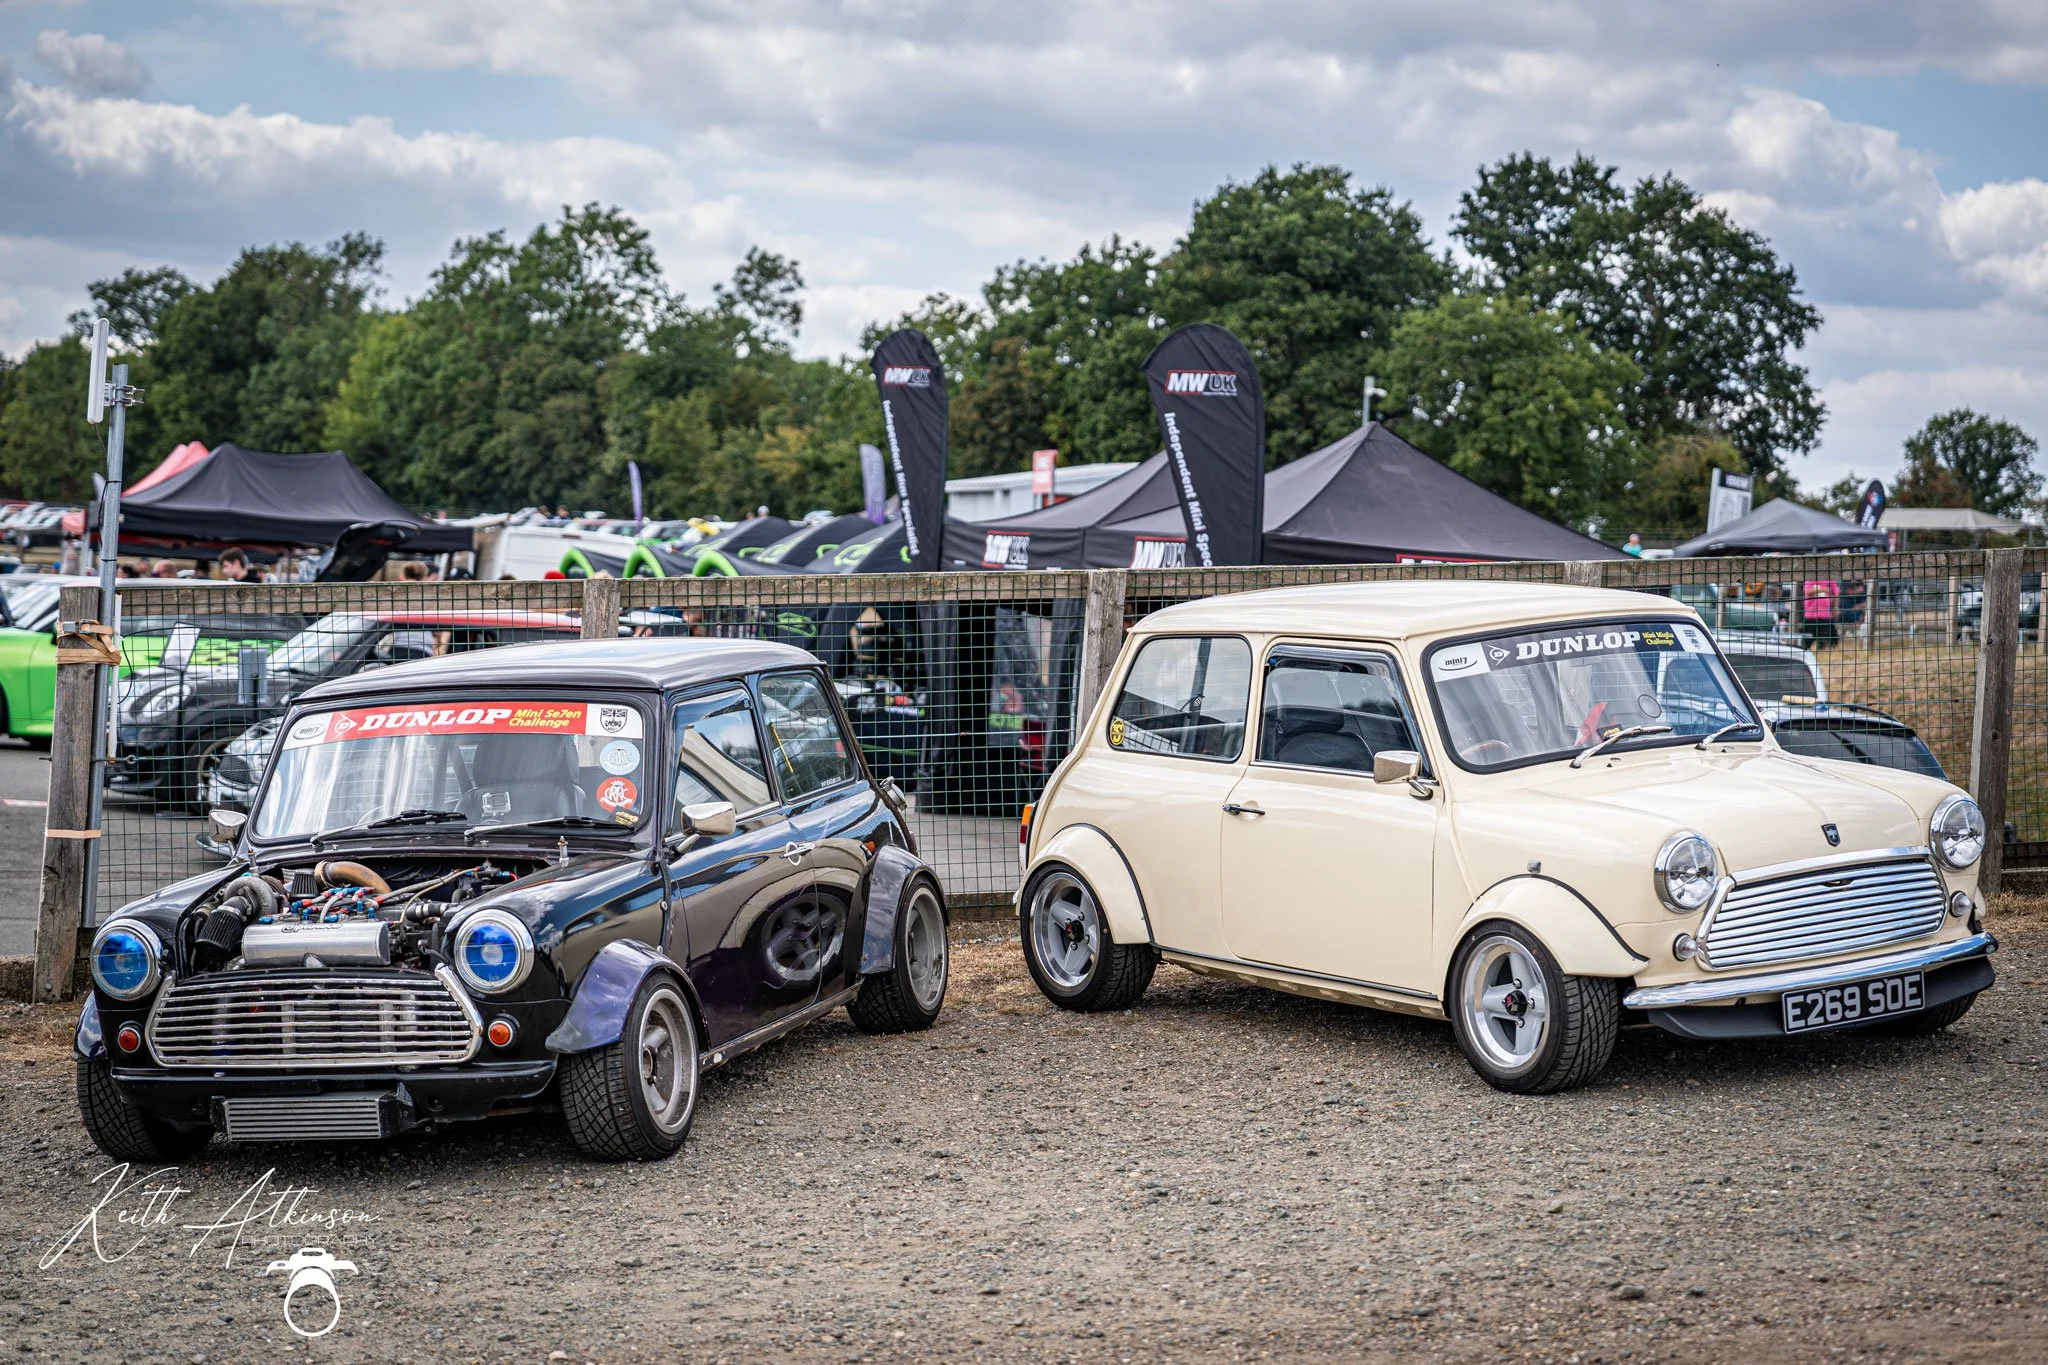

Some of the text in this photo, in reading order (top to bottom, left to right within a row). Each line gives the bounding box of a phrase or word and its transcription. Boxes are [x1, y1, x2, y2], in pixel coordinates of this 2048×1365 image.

[882, 399, 901, 471] Independent
[901, 498, 920, 555] Specialist
[1164, 411, 1198, 499] Independent
[1188, 500, 1207, 532] Mini
[1516, 631, 1641, 661] DUNLOP
[1646, 638, 1675, 646] Challenge
[1444, 657, 1468, 667] mini7
[357, 708, 582, 731] DUNLOP Mini Se7en
[508, 718, 570, 729] Challenge
[1786, 974, 1922, 1029] E269 SOE
